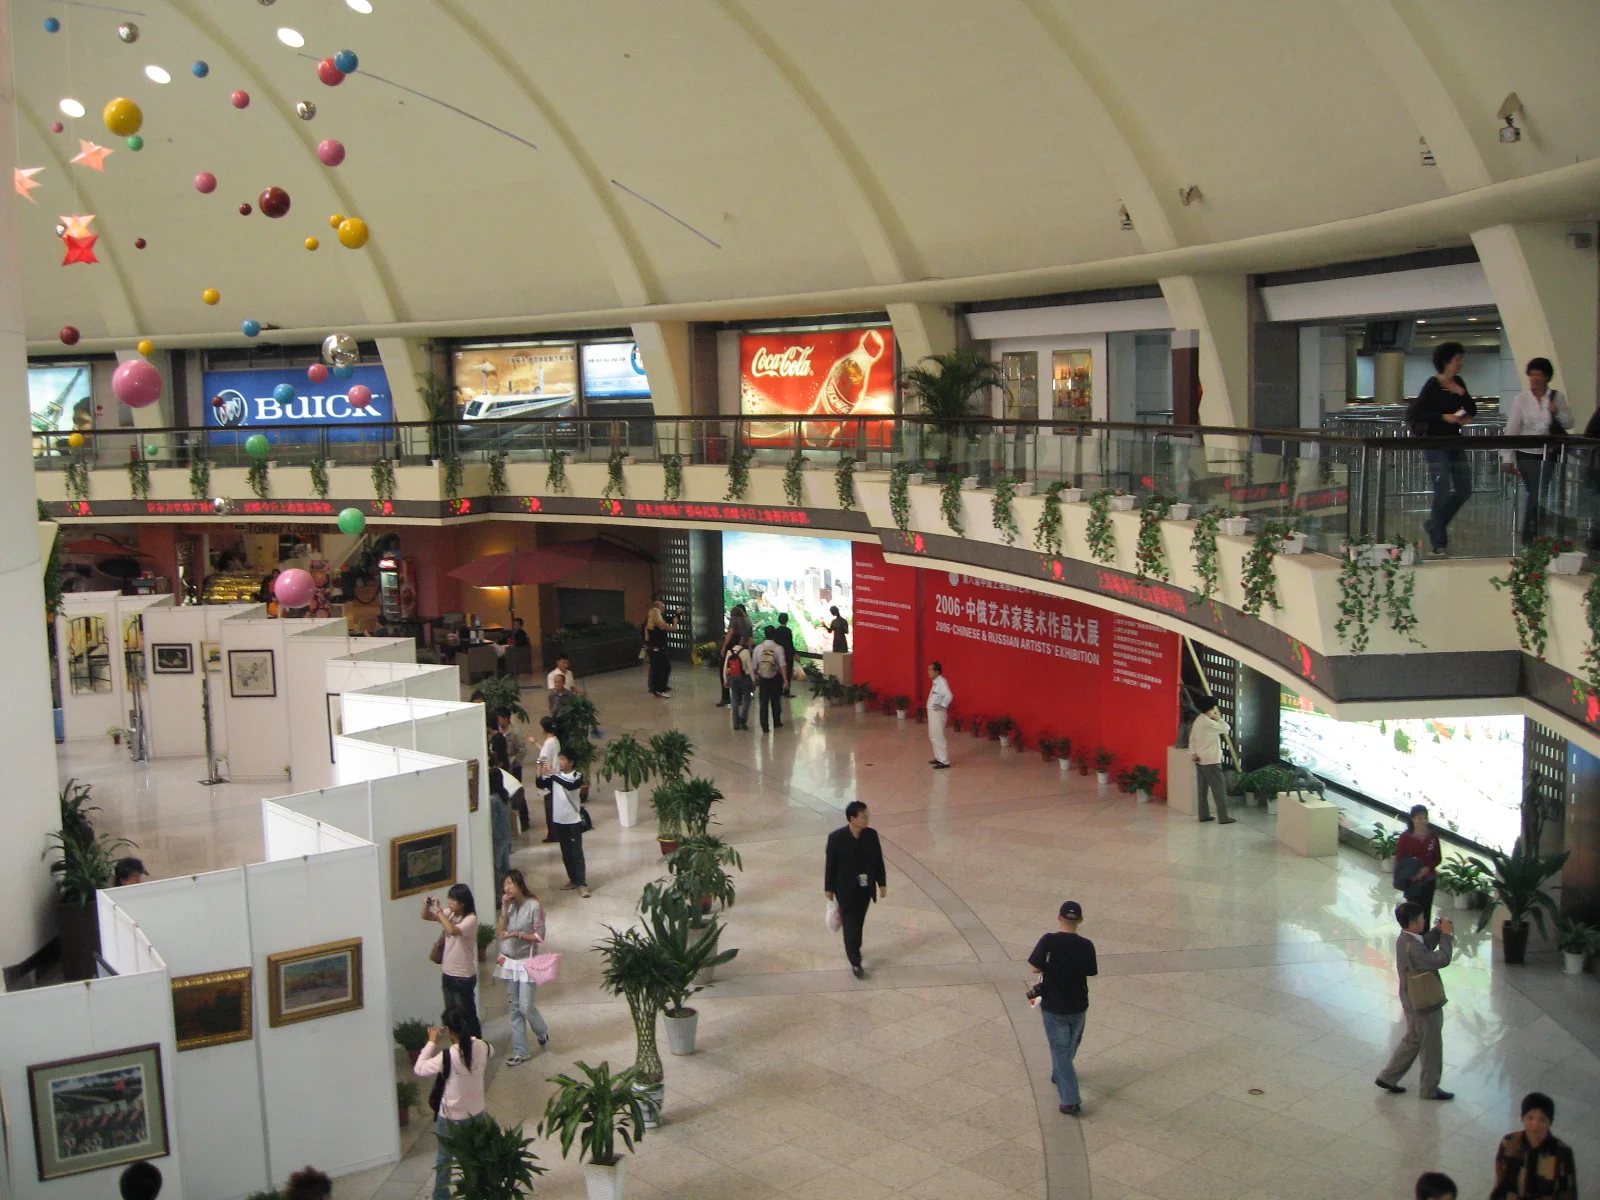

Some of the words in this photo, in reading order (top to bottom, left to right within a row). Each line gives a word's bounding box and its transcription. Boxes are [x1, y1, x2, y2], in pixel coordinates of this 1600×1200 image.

[751, 346, 814, 377] Coca-Cola
[988, 631, 1020, 648] RUSSIAN
[1054, 645, 1100, 665] EXHIBITION
